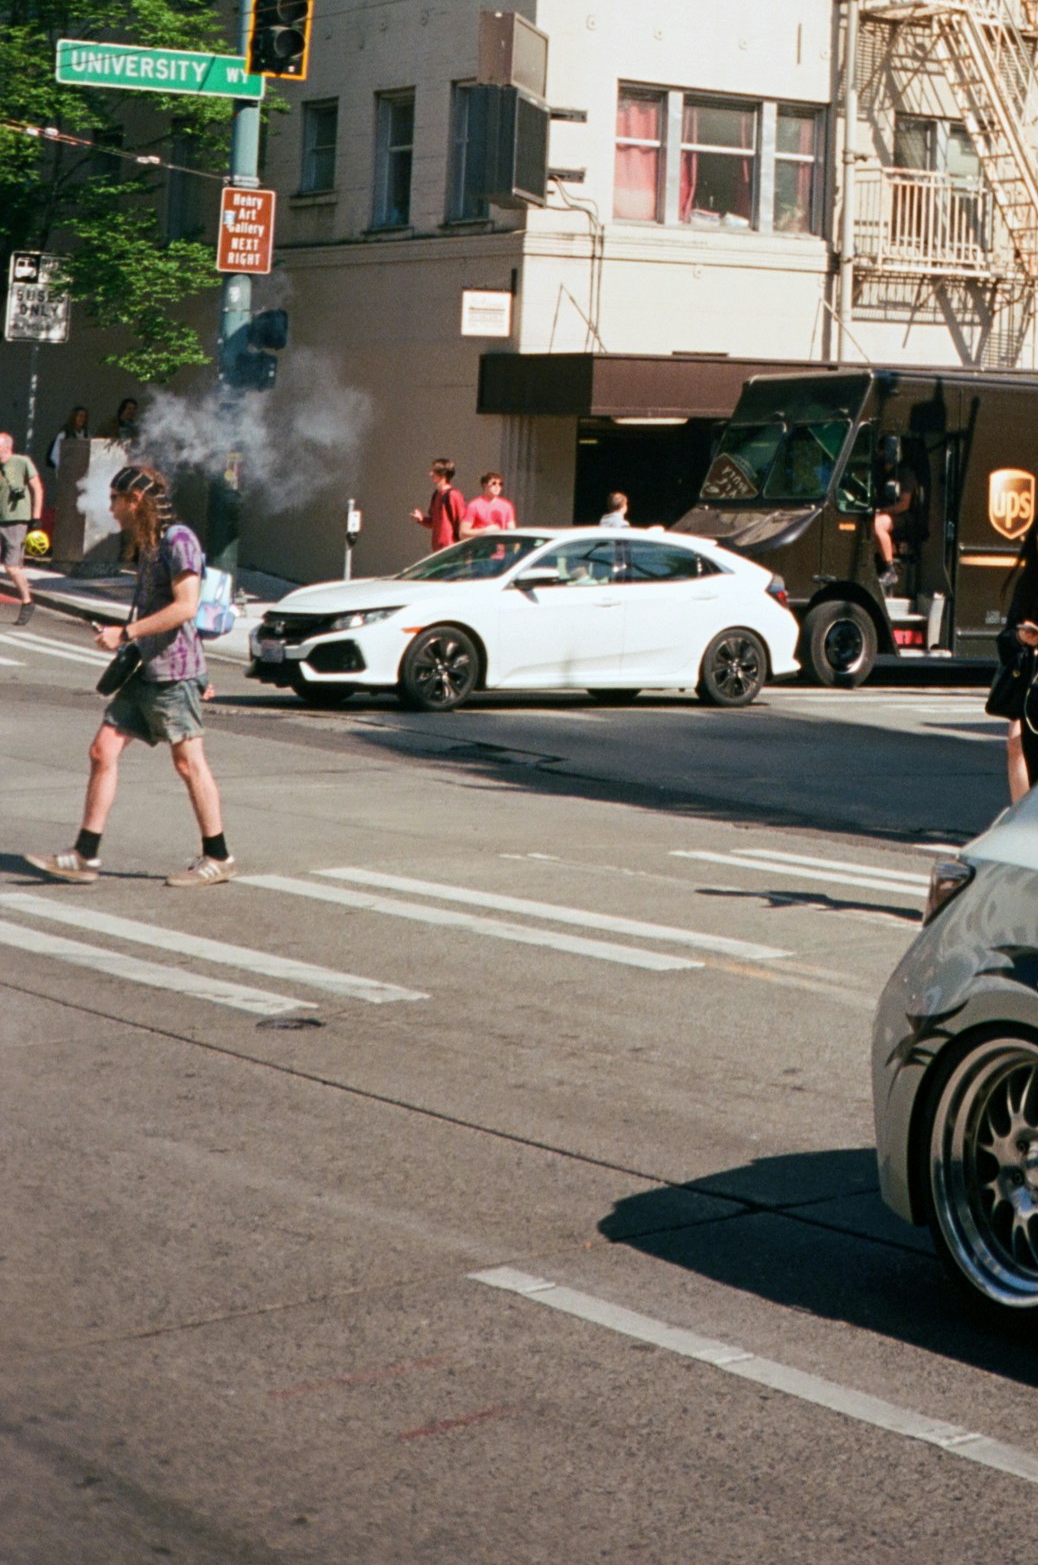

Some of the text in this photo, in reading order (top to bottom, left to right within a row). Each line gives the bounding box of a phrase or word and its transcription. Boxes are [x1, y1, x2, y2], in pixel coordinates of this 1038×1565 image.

[71, 50, 249, 84] UNIVERSITY WY
[233, 193, 263, 210] Henry
[238, 208, 257, 221] Art
[231, 237, 259, 251] NEXT
[227, 251, 261, 266] RIGHT
[993, 491, 1031, 529] ups
